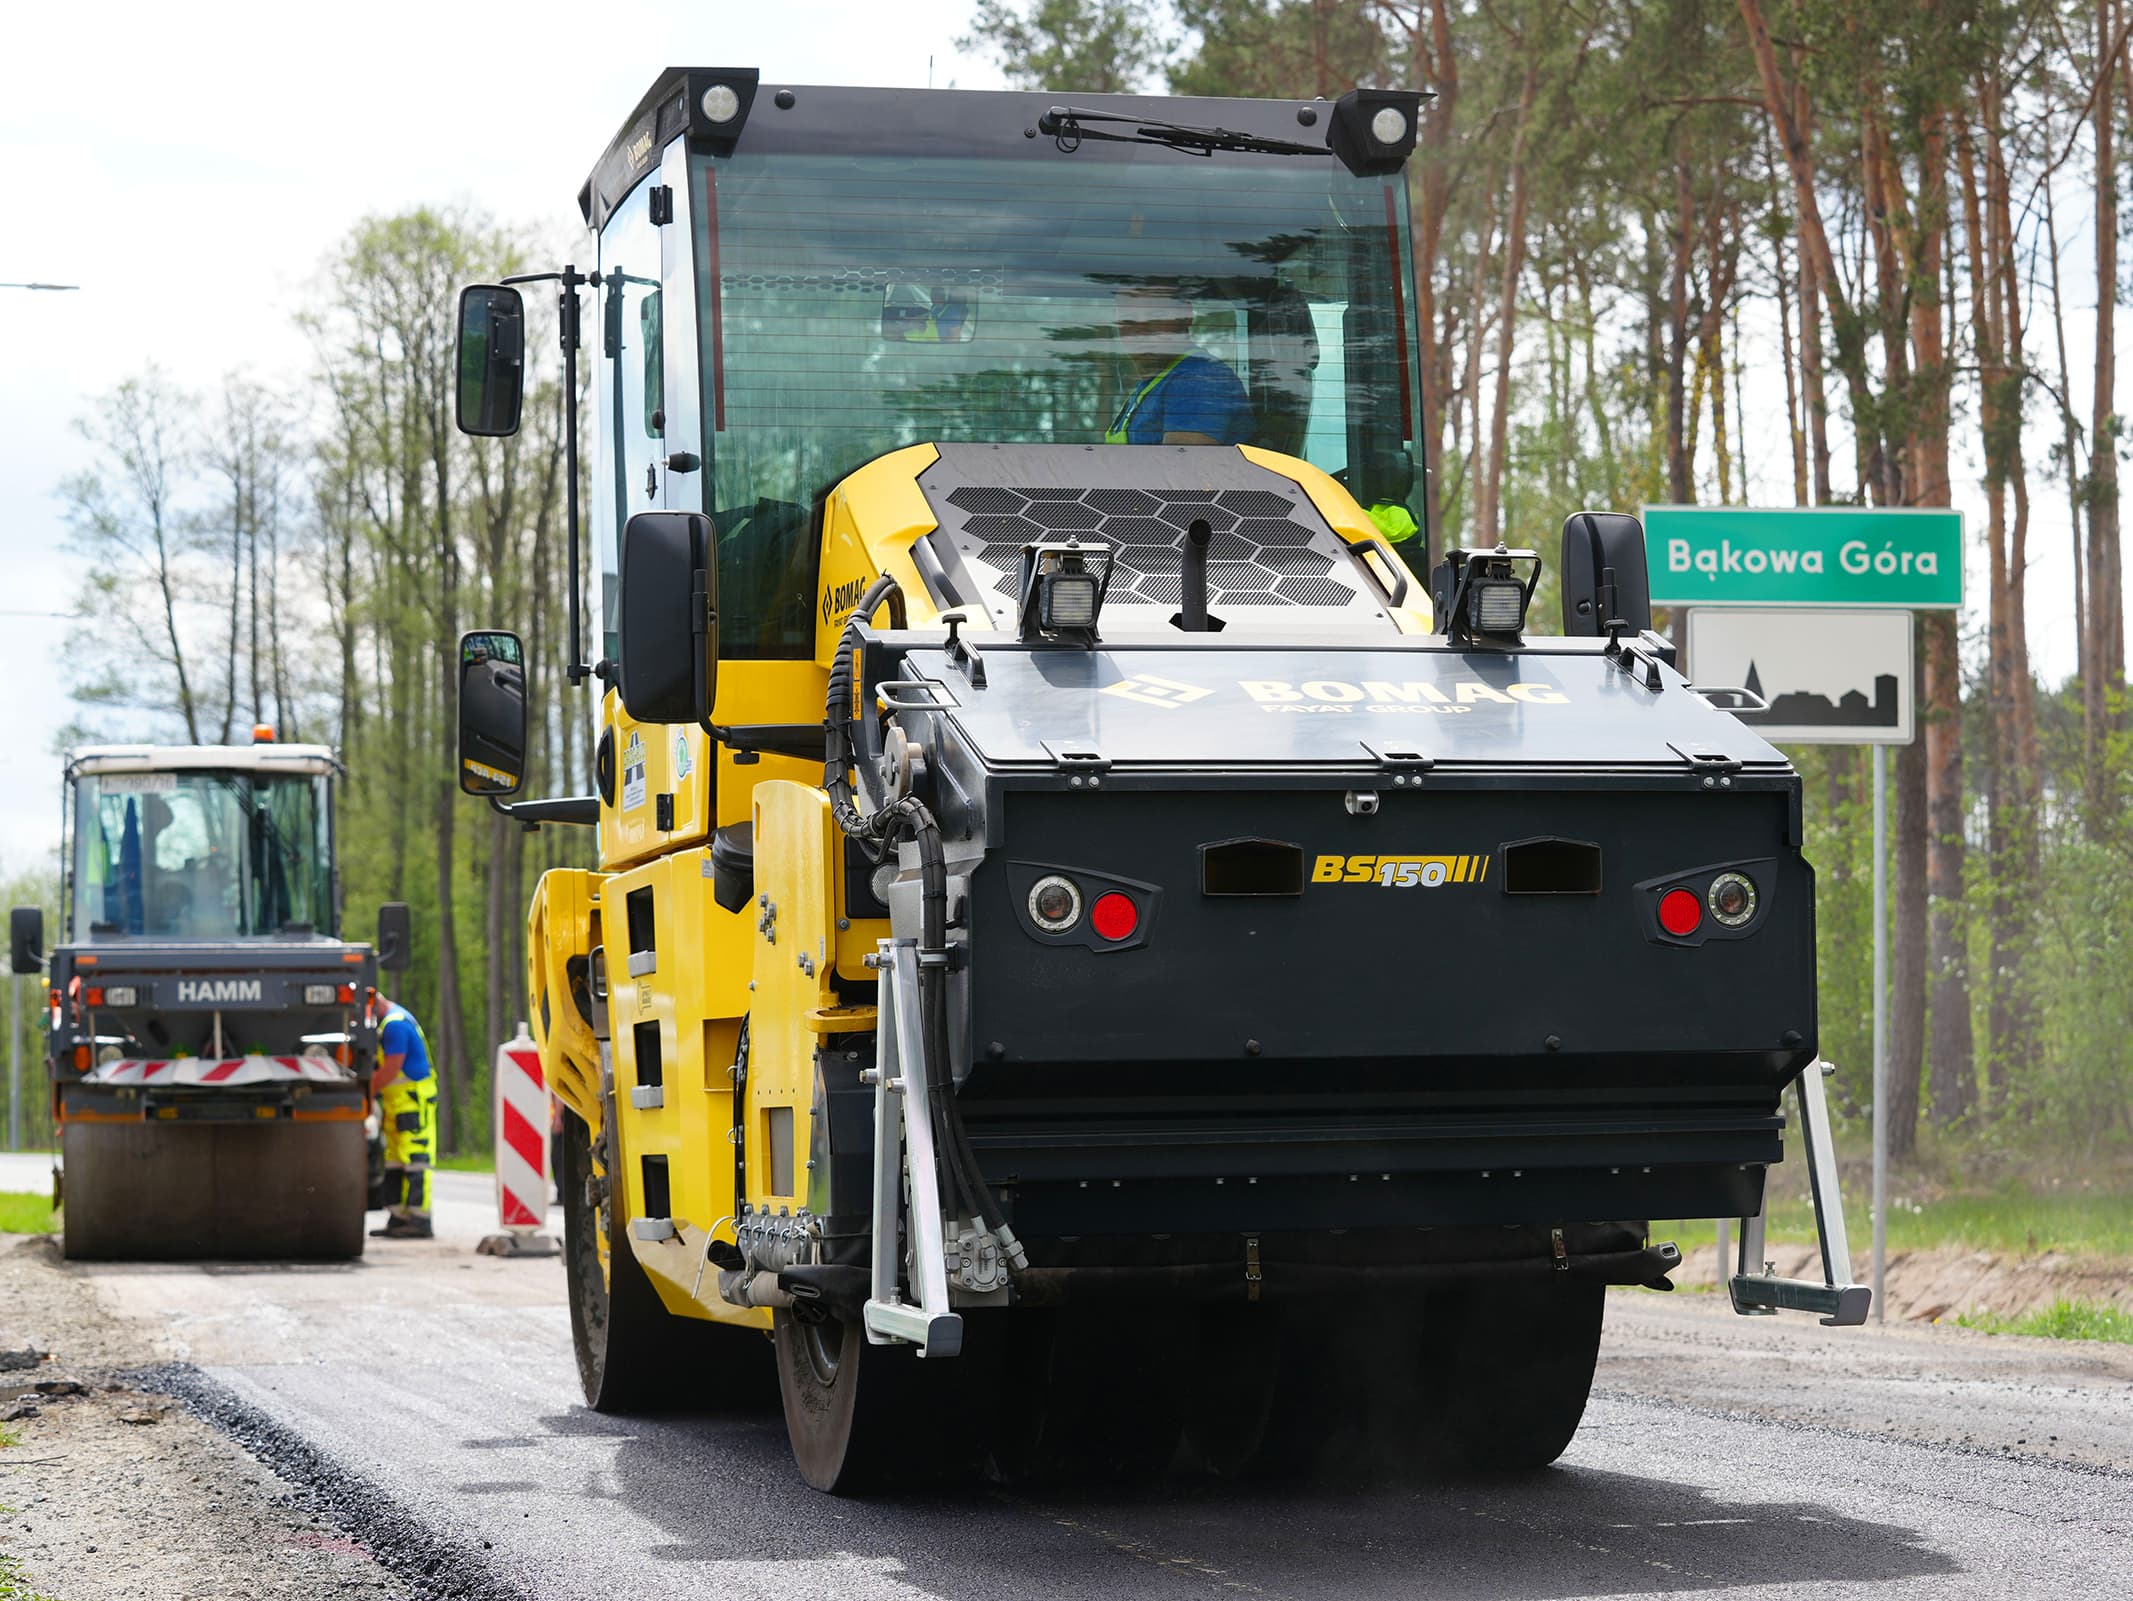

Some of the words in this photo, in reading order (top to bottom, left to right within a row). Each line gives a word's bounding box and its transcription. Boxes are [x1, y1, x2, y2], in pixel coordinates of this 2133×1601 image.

[1668, 538, 1824, 582] Bąkowa
[1839, 540, 1938, 575] Góra
[834, 575, 866, 614] BOMAG
[1237, 680, 1572, 704] BOMAG
[1261, 704, 1353, 713] FAYAT
[1366, 704, 1472, 714] GROUP
[178, 980, 261, 1002] HAMM
